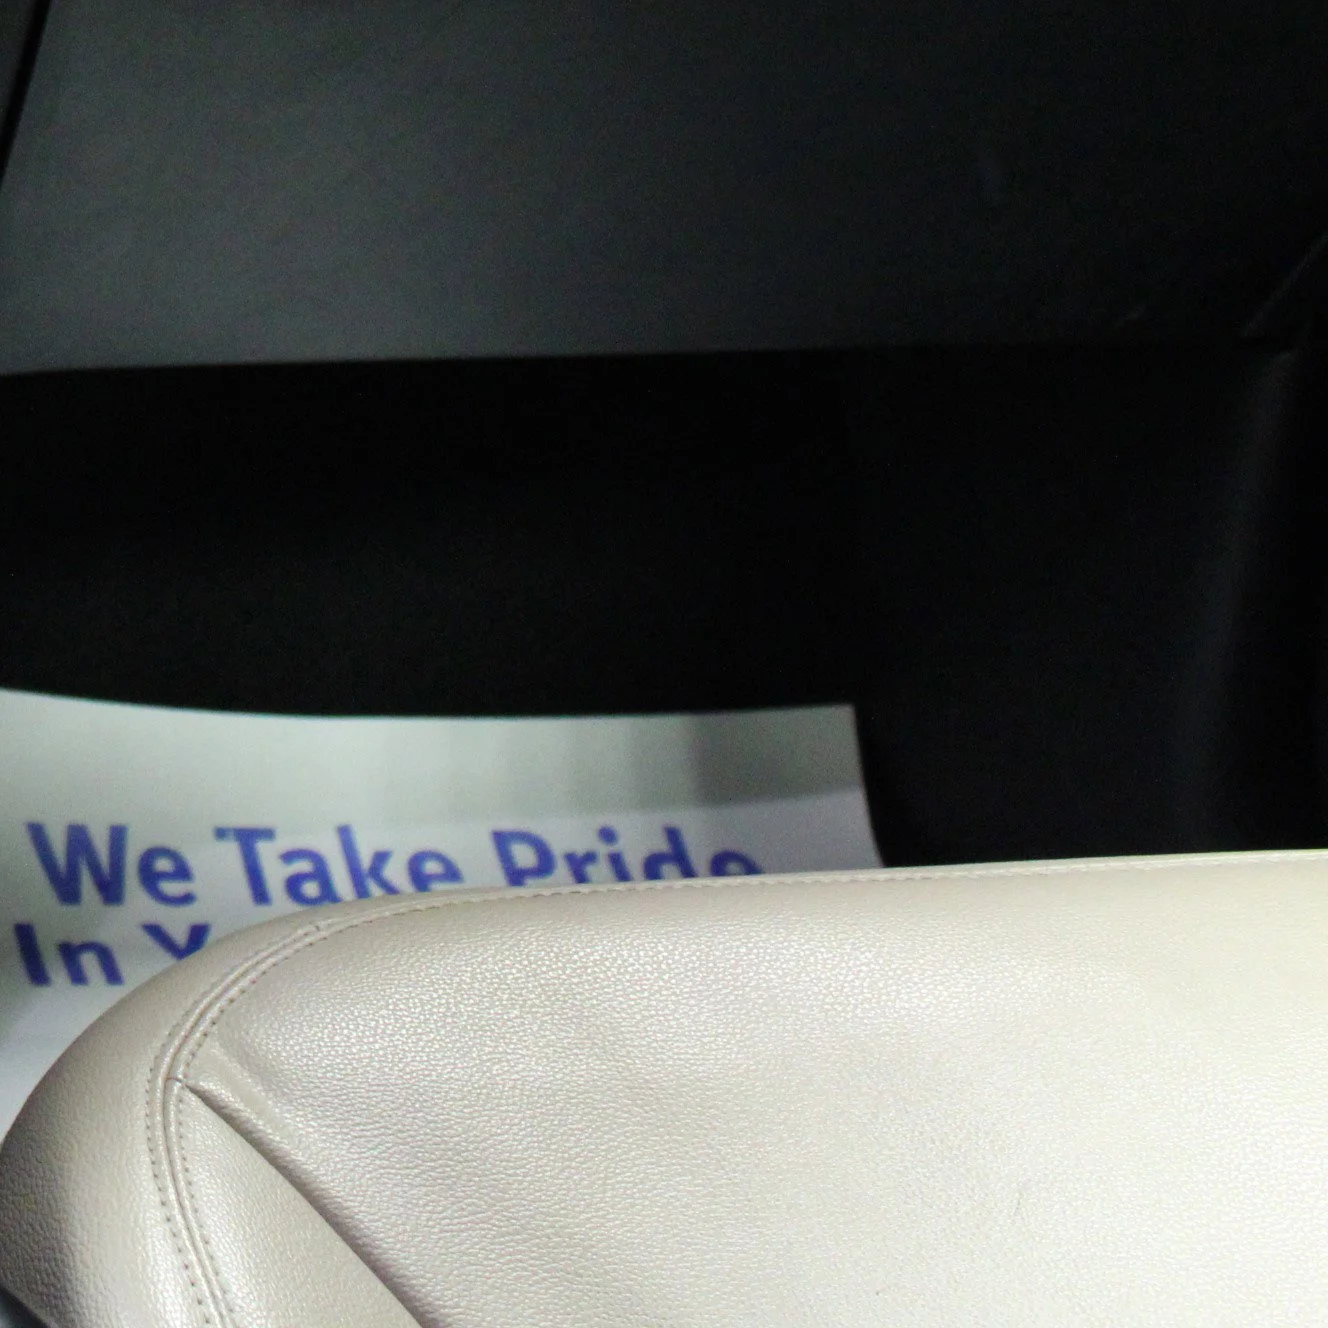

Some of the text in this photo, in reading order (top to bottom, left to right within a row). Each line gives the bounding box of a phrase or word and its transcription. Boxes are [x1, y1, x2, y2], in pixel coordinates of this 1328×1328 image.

[25, 823, 196, 907] We
[213, 825, 464, 907] Take
[13, 923, 125, 987] In
